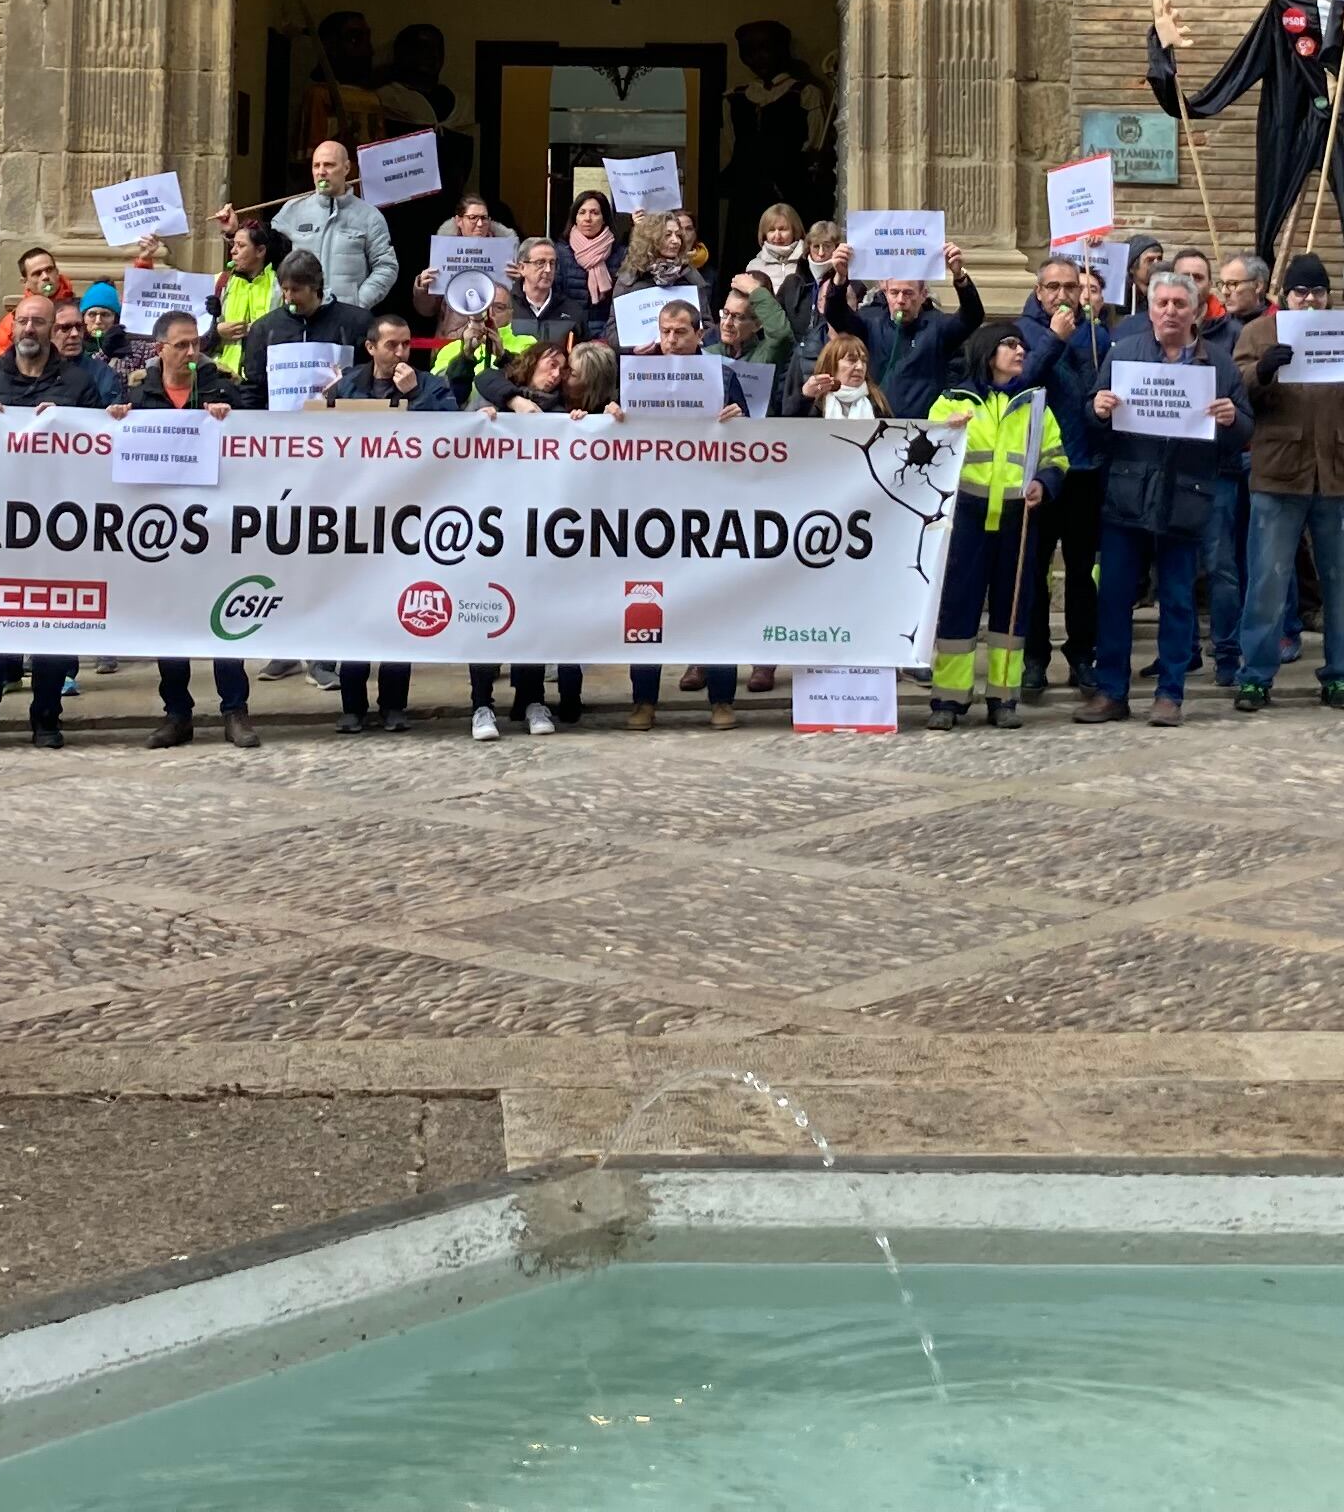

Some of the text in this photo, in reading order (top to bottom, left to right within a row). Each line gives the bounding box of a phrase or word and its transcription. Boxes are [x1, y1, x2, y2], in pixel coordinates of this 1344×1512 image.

[1282, 16, 1306, 26] PSOE
[1114, 161, 1161, 176] HUESCA
[7, 430, 112, 455] MENOS
[221, 430, 789, 464] IENTES Y MÁS CUMPLIR COMPROMISOS
[231, 489, 504, 567] PÚBLIC@S
[525, 507, 874, 570] IGNORAD@S
[225, 595, 284, 618] CSIF
[404, 590, 446, 613] UGT
[458, 599, 503, 610] Servicios
[42, 620, 50, 628] la
[458, 612, 499, 623] Públicos
[626, 628, 661, 642] CGT
[762, 625, 851, 643] #BastaYa
